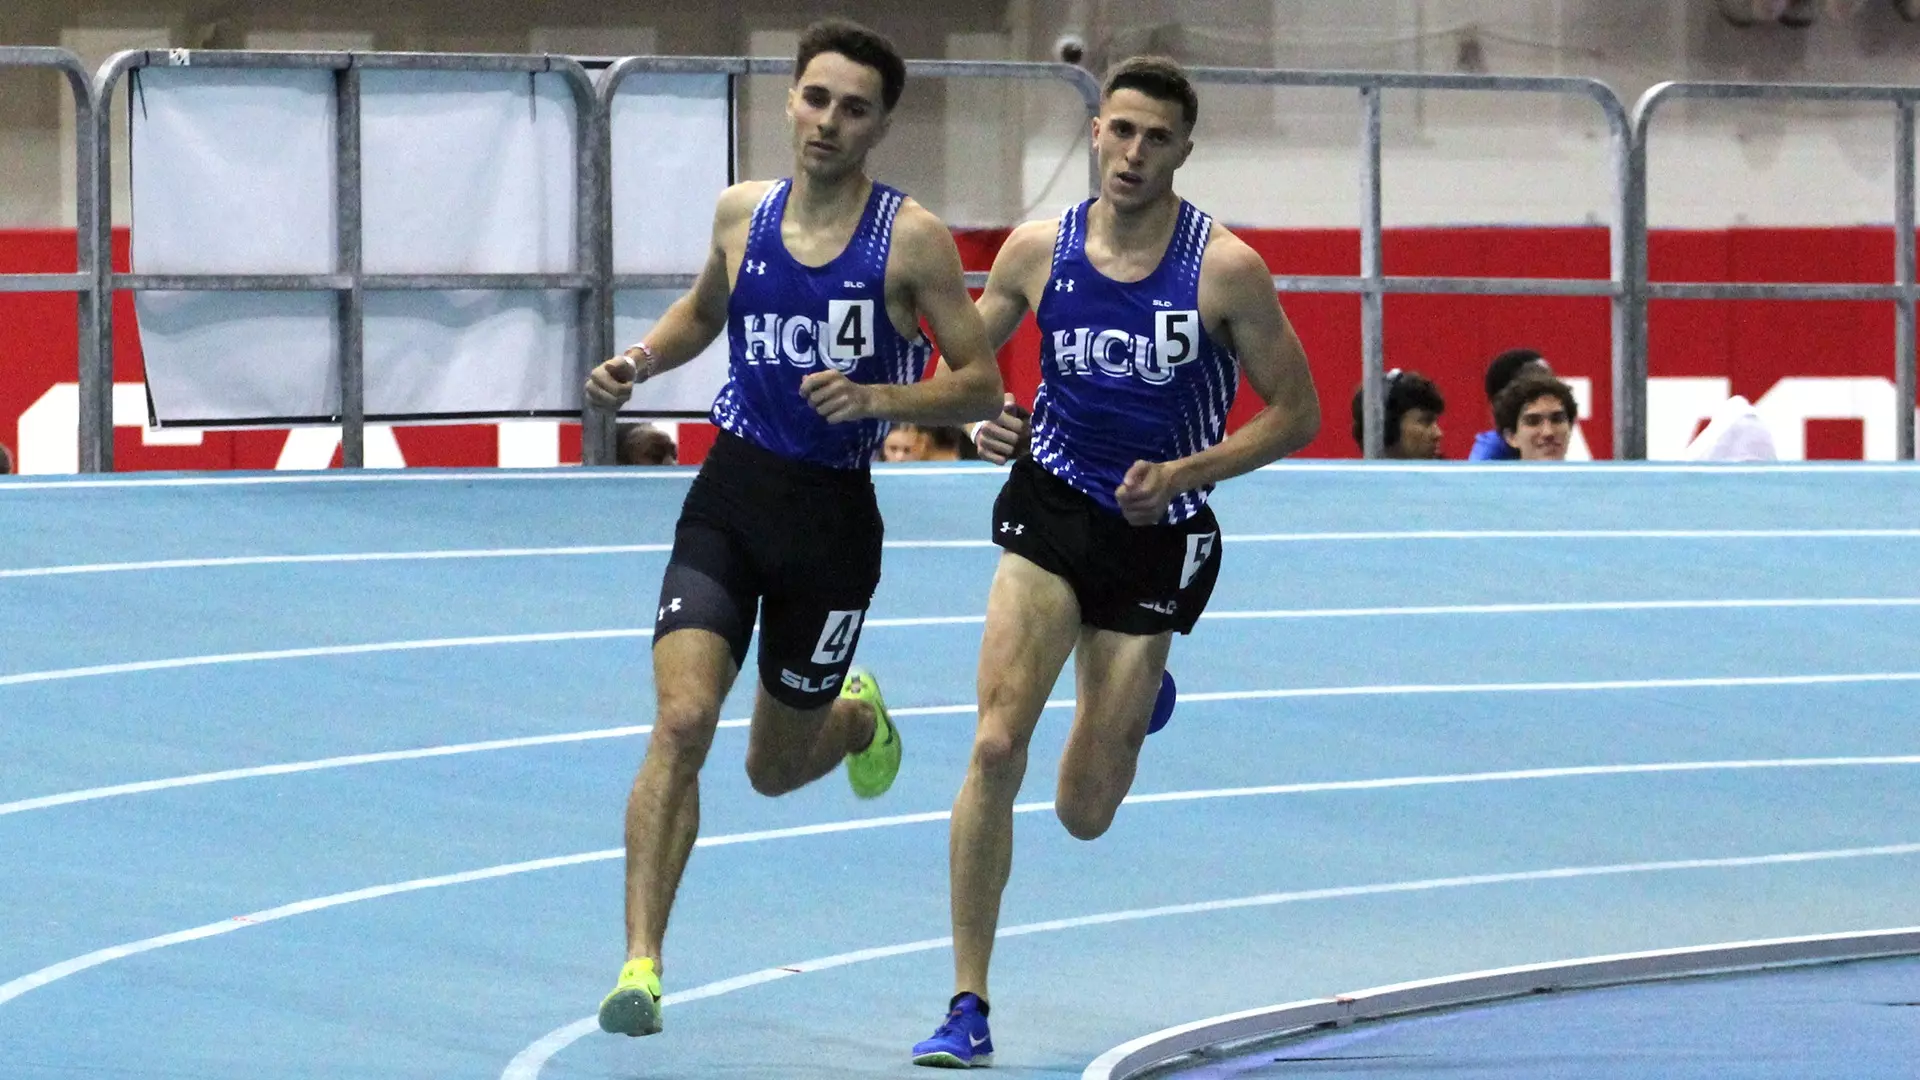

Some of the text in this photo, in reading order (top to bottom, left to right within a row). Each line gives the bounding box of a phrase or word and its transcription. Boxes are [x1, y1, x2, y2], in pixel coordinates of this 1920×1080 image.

[743, 313, 858, 375] HCU
[836, 305, 866, 356] 4
[1166, 314, 1191, 364] 5
[1052, 327, 1176, 386] HCU
[821, 614, 853, 661] 4
[780, 668, 841, 693] SLC
